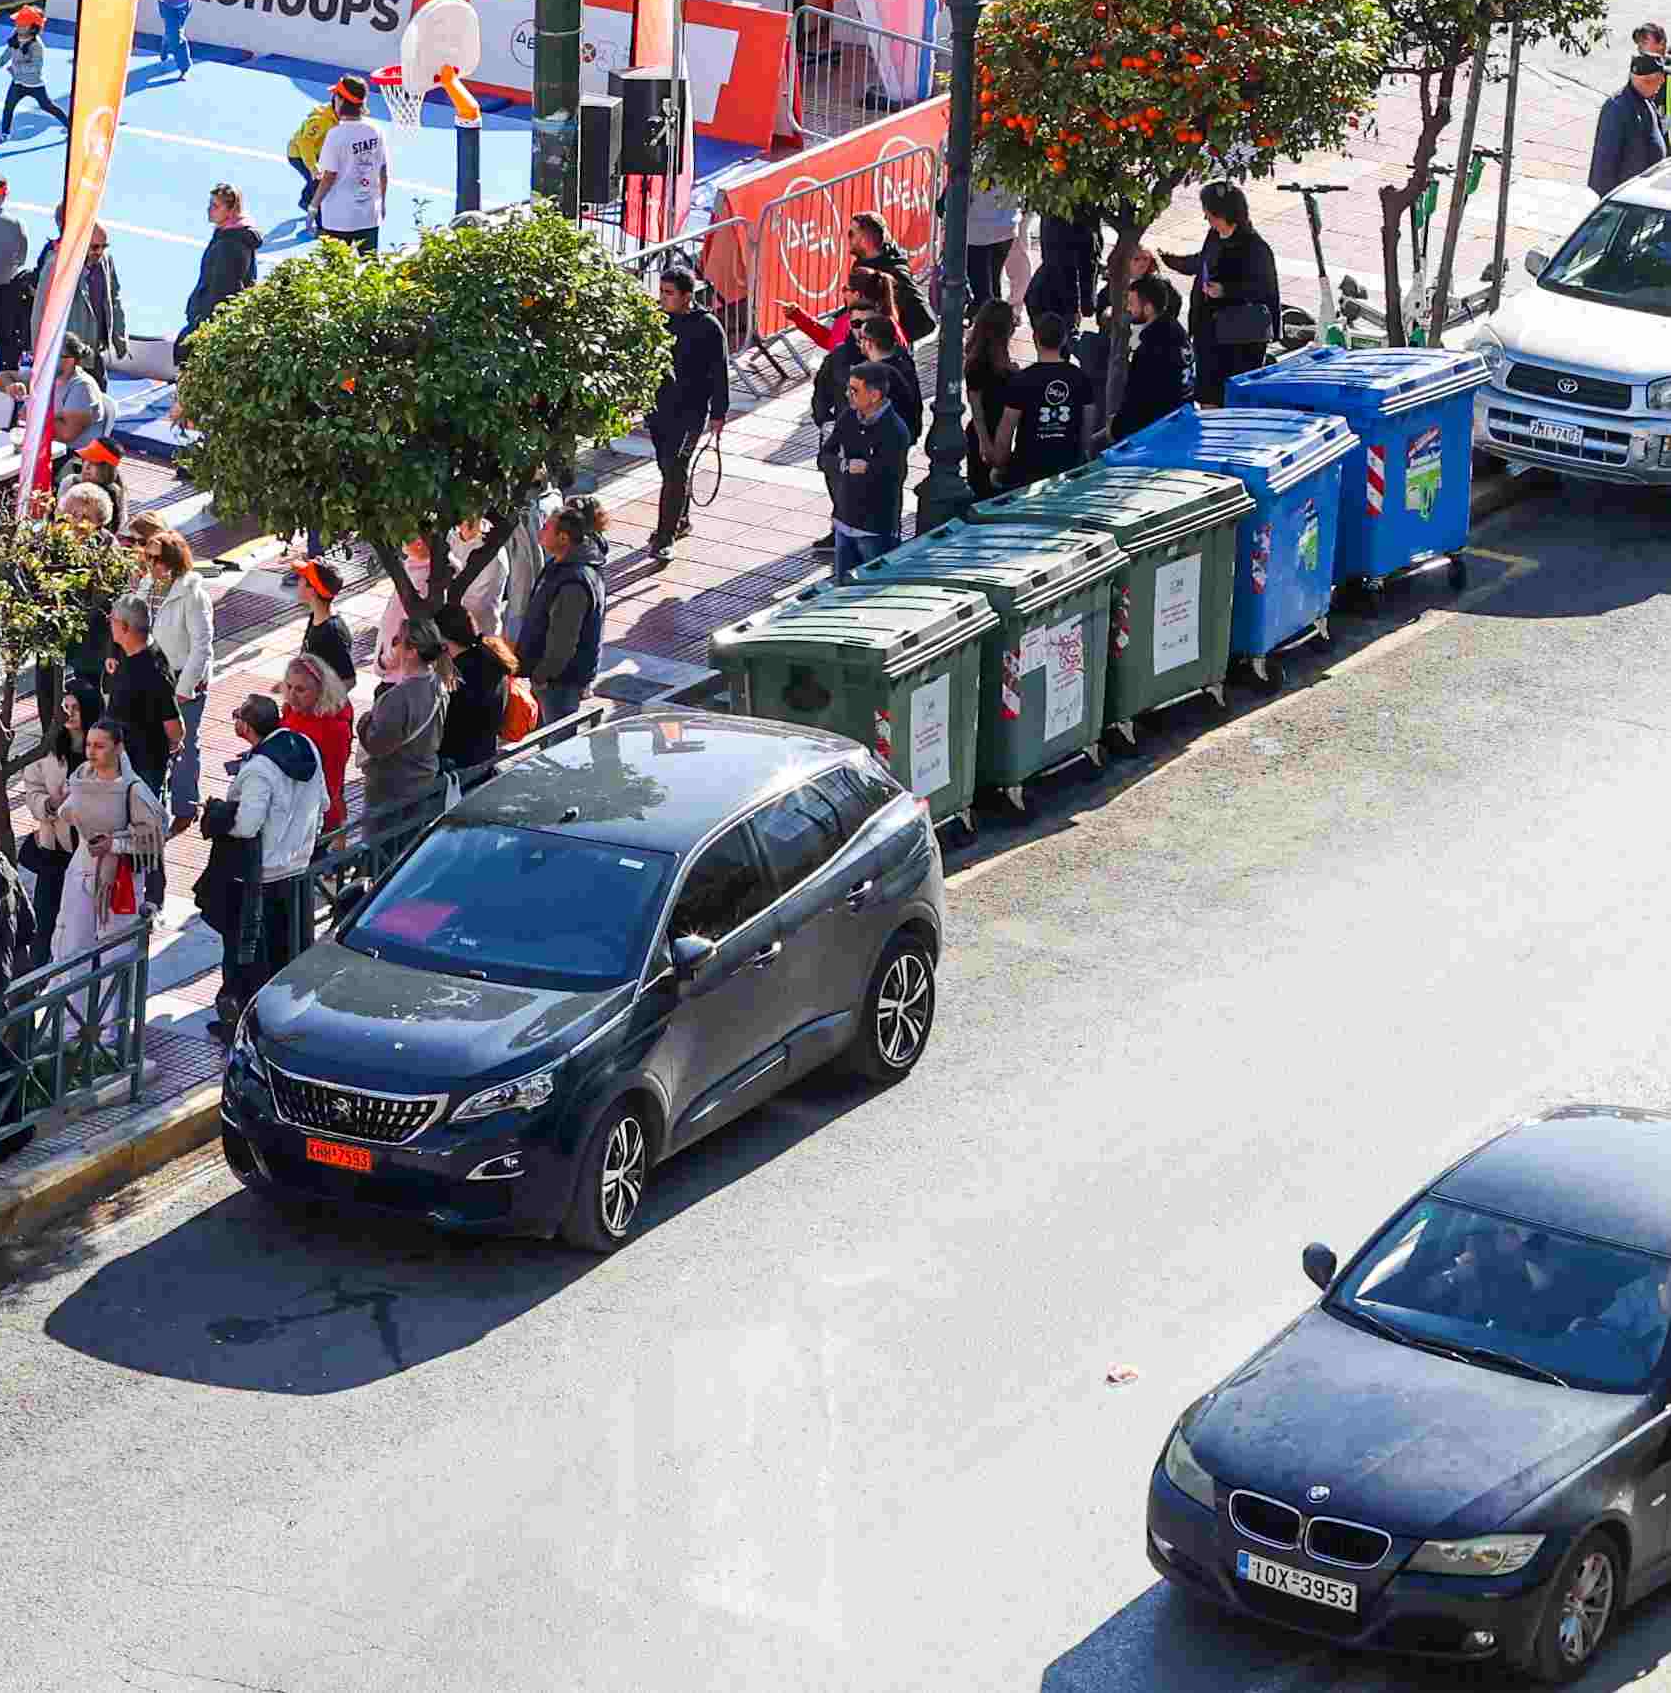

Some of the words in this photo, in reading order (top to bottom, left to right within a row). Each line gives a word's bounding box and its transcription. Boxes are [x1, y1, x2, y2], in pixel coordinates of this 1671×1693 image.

[514, 32, 537, 50] ΔΕ
[351, 137, 379, 154] STAFF
[787, 218, 836, 257] ΔΕΗ
